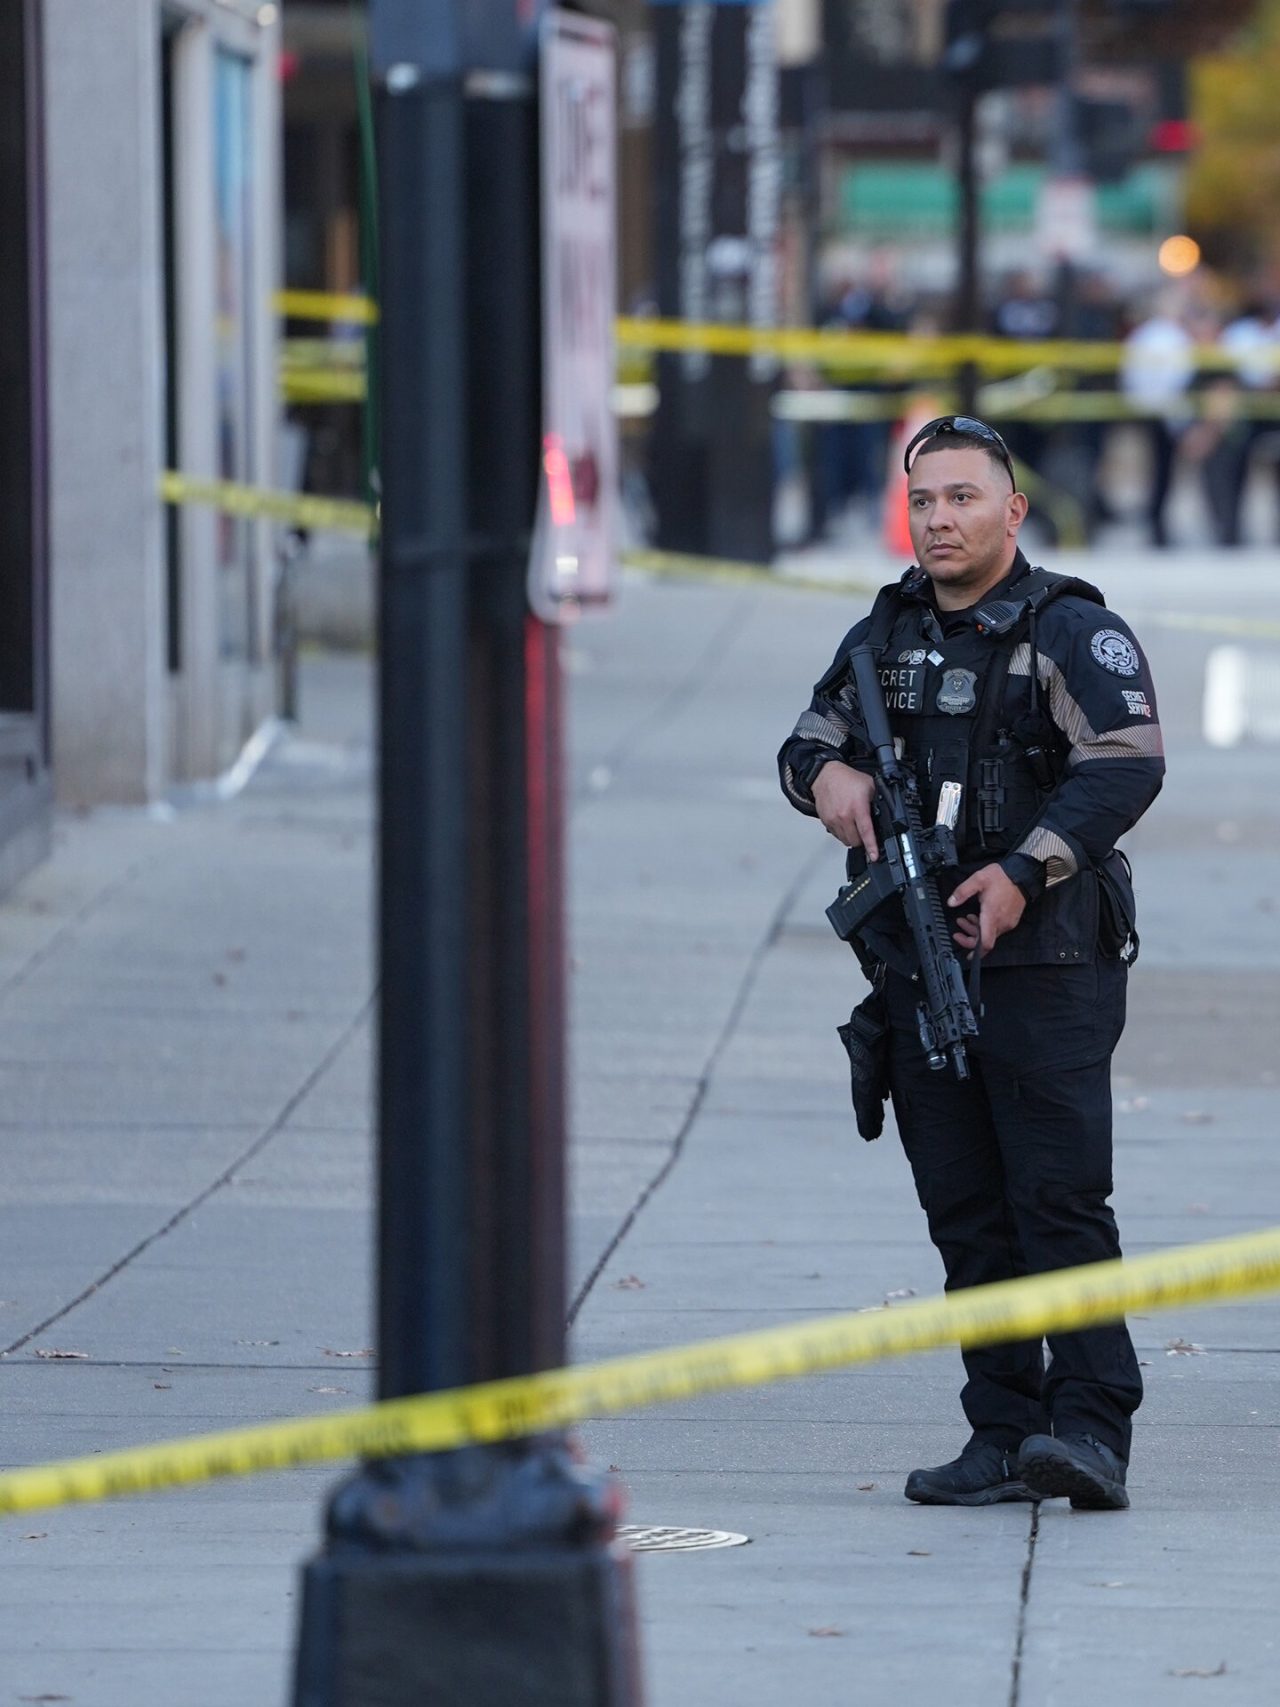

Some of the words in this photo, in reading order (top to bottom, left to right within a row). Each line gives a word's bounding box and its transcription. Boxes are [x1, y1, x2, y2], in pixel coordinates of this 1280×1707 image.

[878, 669, 917, 687] CRET
[885, 692, 917, 710] VICE
[1121, 690, 1147, 704] SECRET
[1127, 702, 1152, 718] SERVICE
